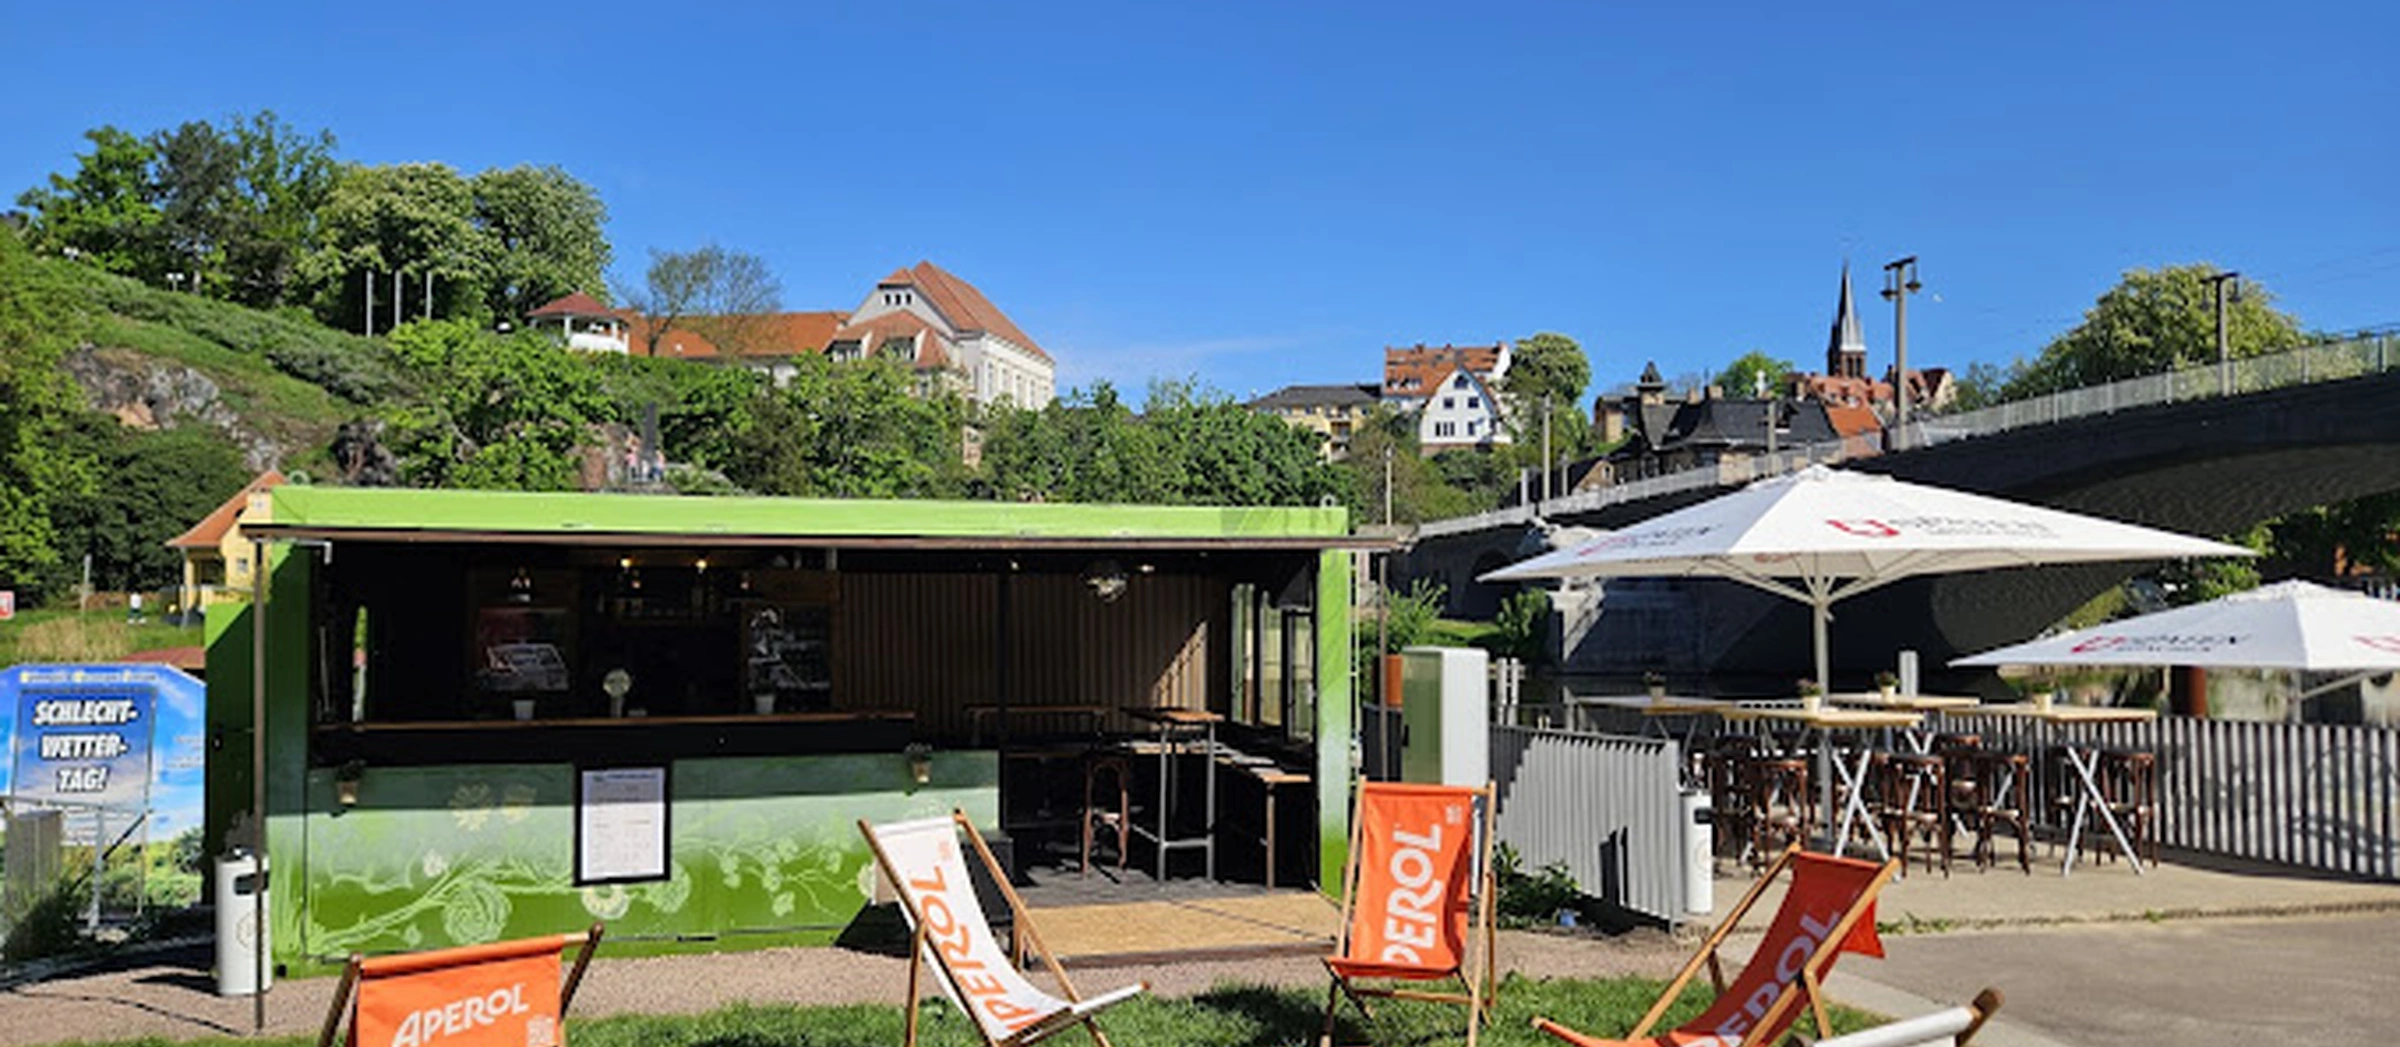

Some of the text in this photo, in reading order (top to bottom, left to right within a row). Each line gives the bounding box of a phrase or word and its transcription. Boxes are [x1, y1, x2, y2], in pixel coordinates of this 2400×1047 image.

[33, 700, 139, 724] SCHLECHT-
[41, 734, 128, 757] WETTER-
[59, 767, 108, 792] TAG!
[390, 983, 530, 1047] APEROL
